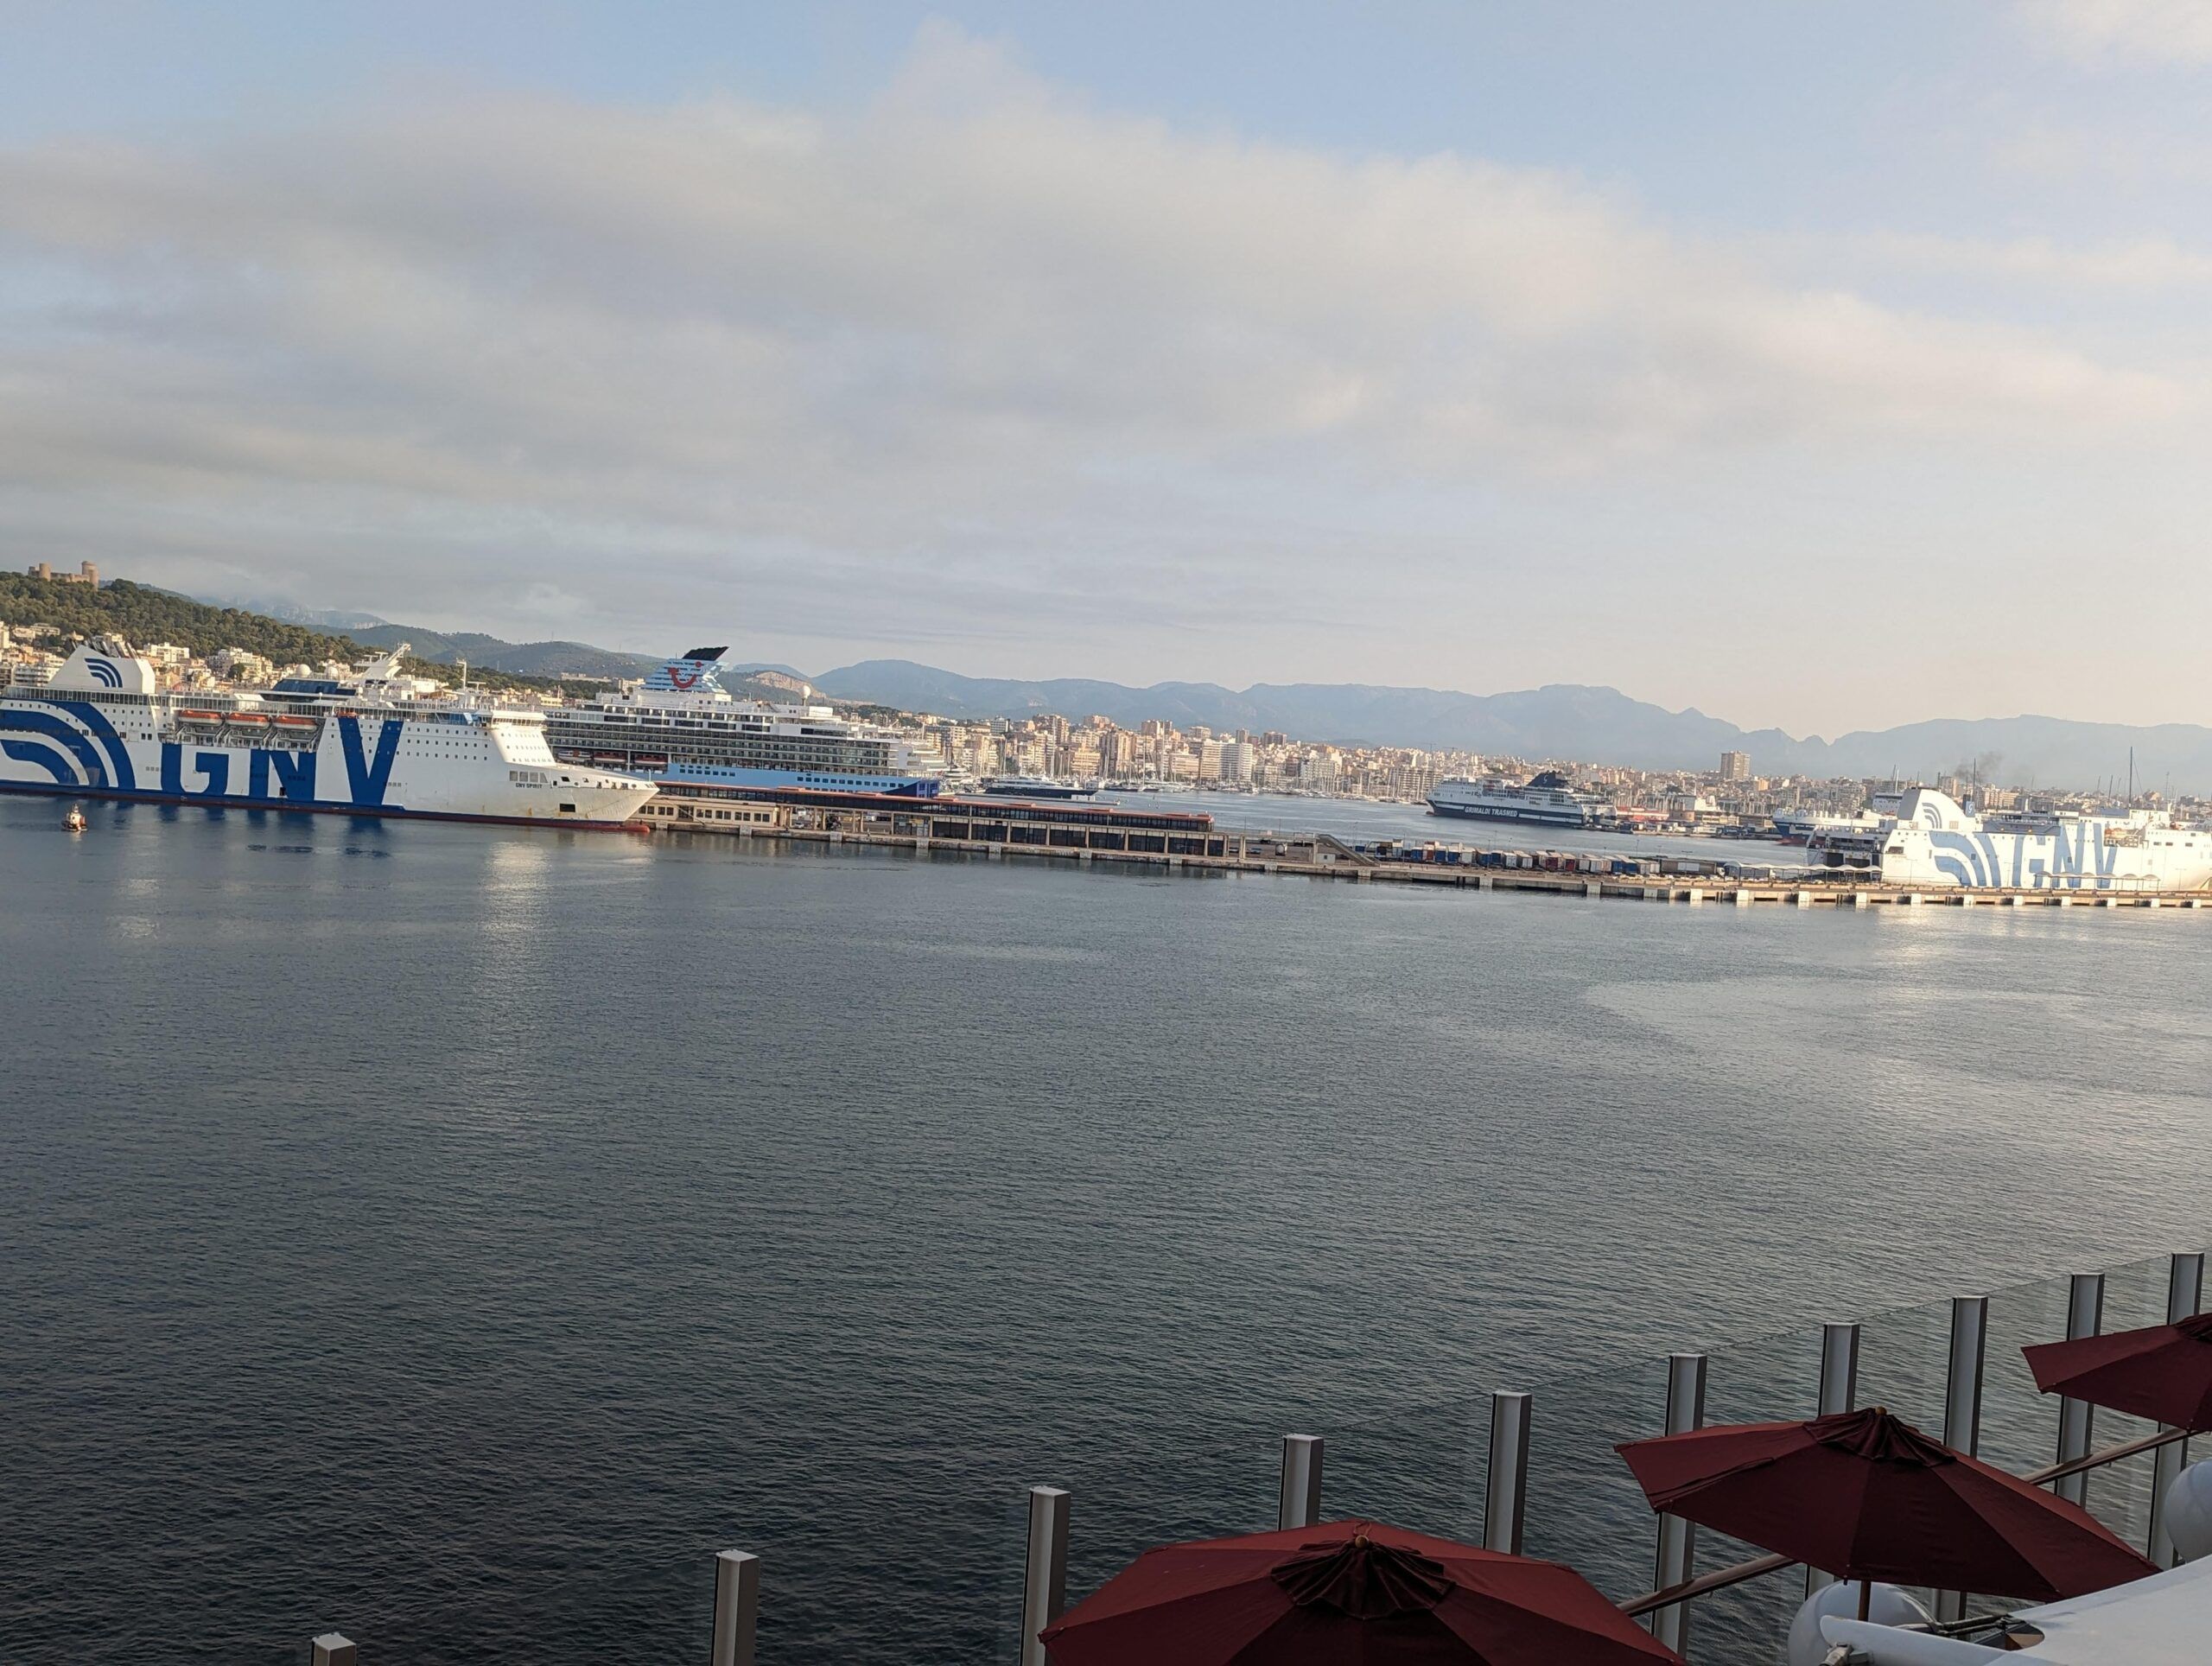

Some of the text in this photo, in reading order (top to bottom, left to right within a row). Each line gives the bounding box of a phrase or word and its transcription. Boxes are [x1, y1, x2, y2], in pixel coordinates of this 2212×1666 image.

[160, 716, 404, 805] GNV
[1465, 806, 1519, 817] GRIMALDI TRASMED
[2012, 822, 2118, 889] GNV
